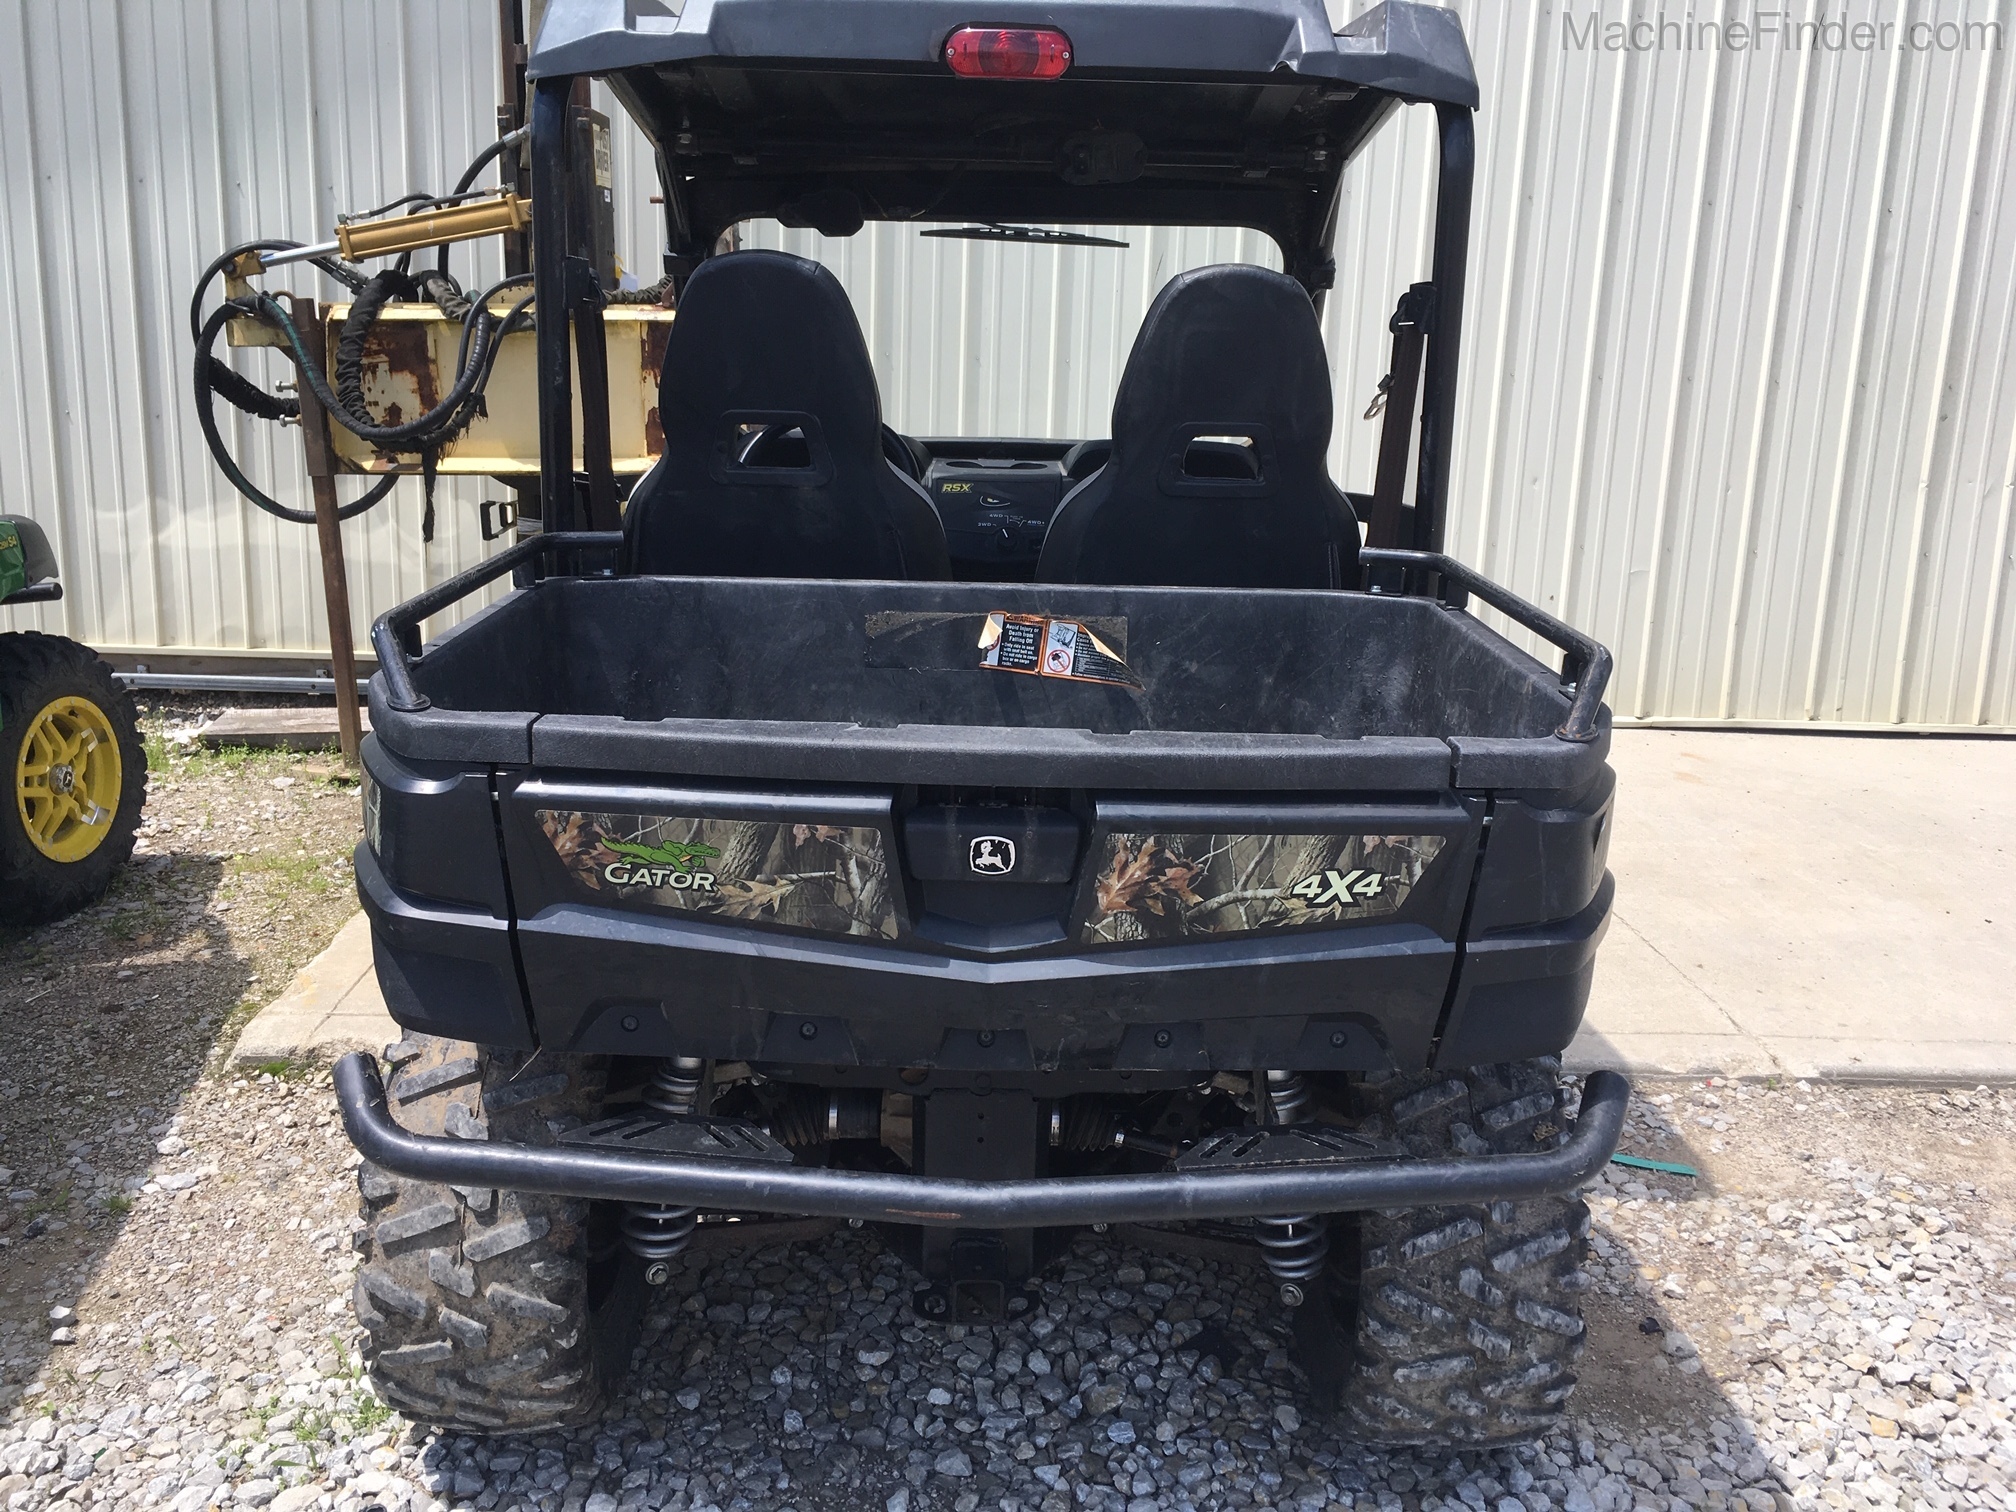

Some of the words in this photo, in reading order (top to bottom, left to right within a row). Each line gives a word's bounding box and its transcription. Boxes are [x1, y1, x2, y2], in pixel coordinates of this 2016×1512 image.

[942, 483, 973, 493] RSX
[1020, 625, 1033, 633] Injury
[1009, 636, 1025, 644] Falling
[604, 862, 716, 891] GATOR
[1291, 869, 1383, 904] 4X4
